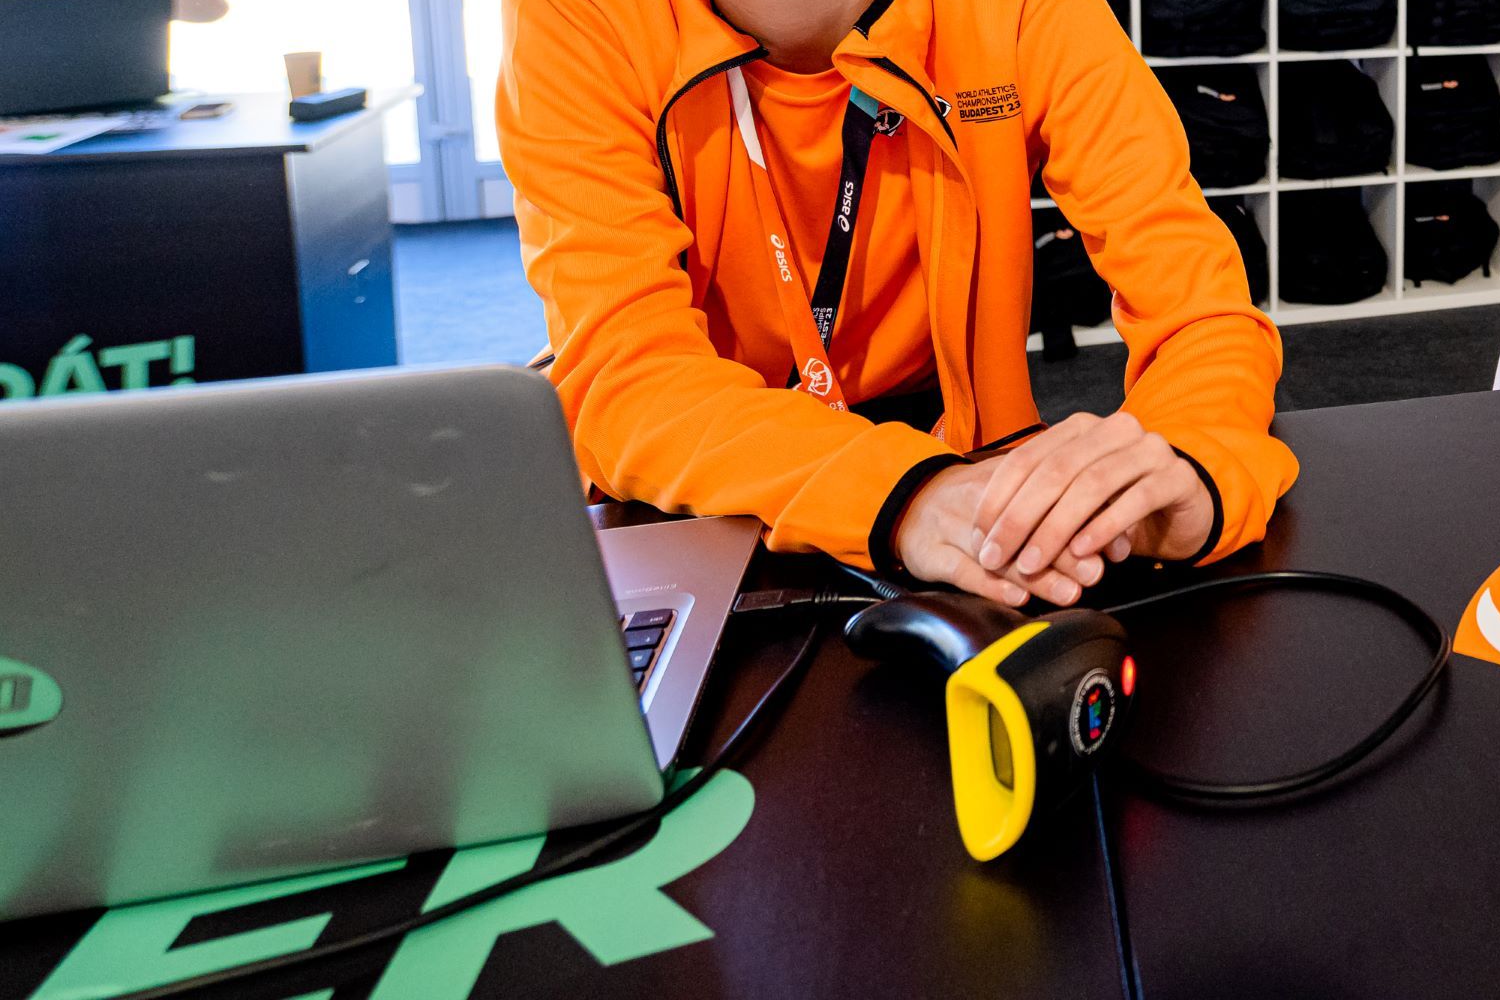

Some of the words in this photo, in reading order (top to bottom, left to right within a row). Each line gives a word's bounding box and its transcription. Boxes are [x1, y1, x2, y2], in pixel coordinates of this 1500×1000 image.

[956, 90, 977, 99] WORLD
[978, 83, 1016, 96] ATHLETICS
[957, 91, 1019, 109] CHAMPIONSHIPS
[959, 105, 1005, 119] BUDAPEST
[1006, 100, 1021, 112] 23
